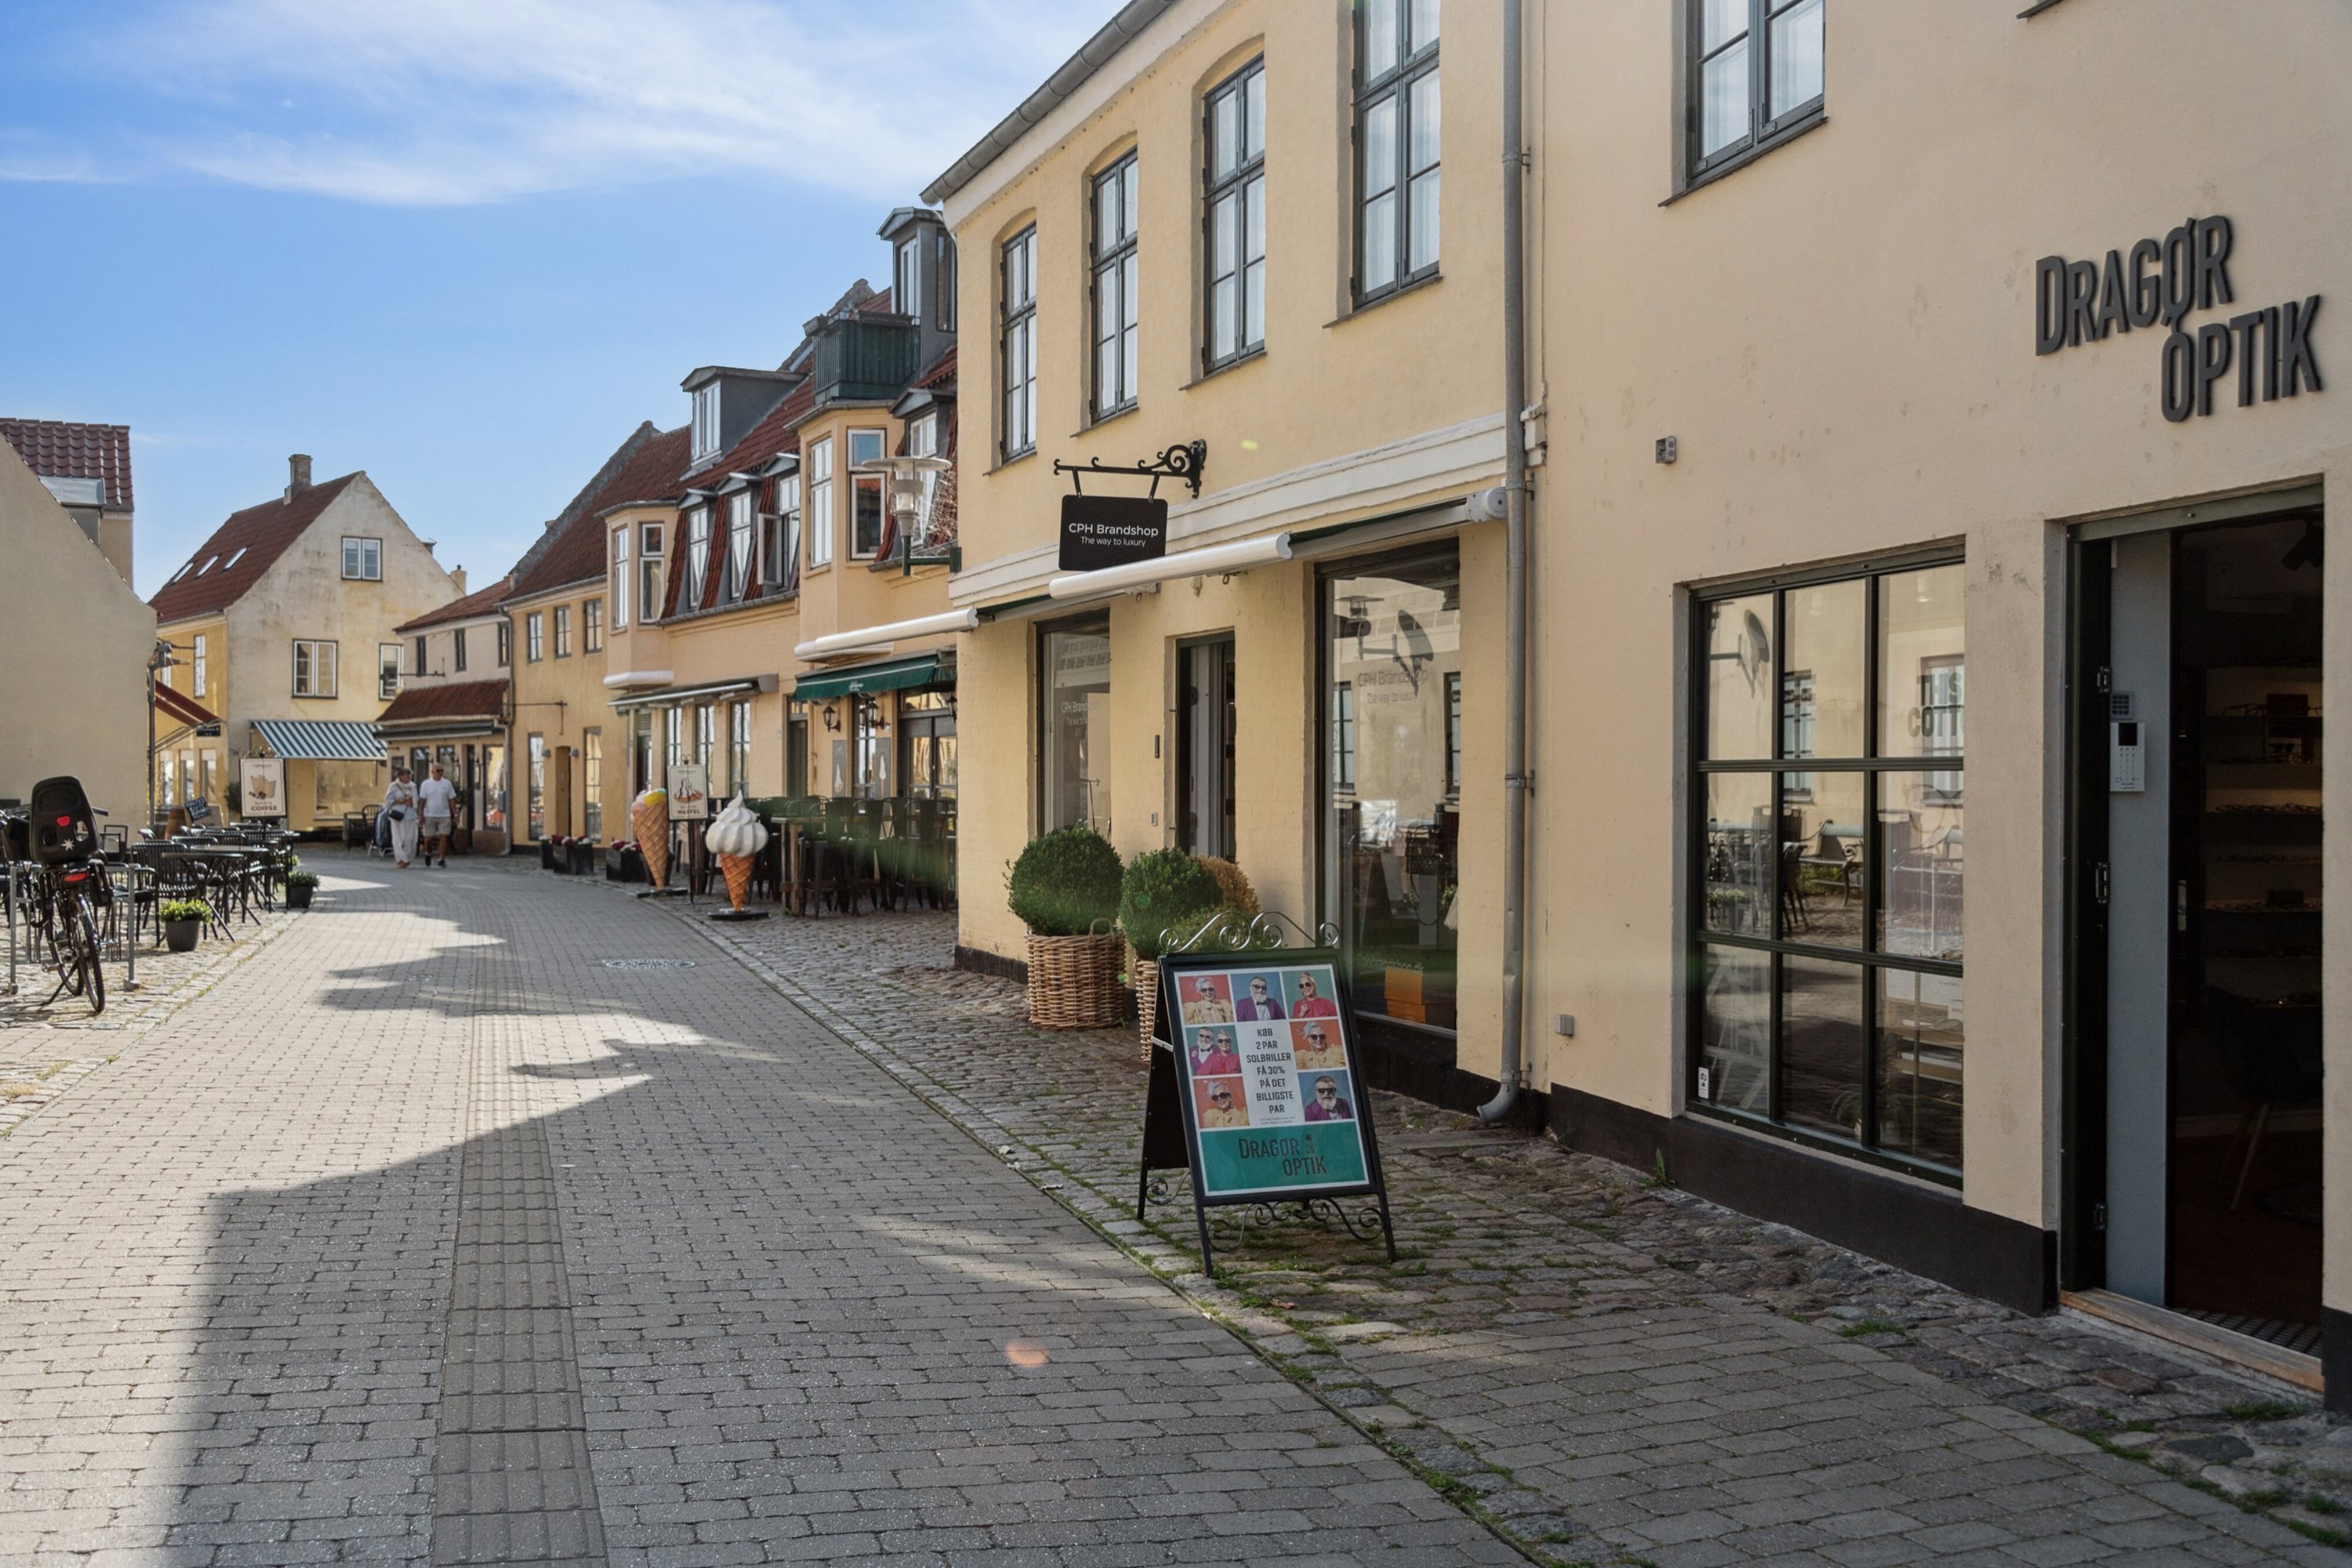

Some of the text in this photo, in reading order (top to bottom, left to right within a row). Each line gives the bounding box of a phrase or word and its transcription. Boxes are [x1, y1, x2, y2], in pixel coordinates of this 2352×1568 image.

[2036, 215, 2234, 356] DRAGØR
[2161, 294, 2323, 423] OPTIK
[1069, 523, 1159, 537] CPH Brandshop
[1081, 536, 1146, 547] The way to luxury
[1907, 706, 1964, 739] COTT
[1257, 1028, 1273, 1036] KØB
[1256, 1040, 1278, 1050] 2 PAR
[1247, 1052, 1291, 1063] SOLBRILLER
[1257, 1065, 1285, 1075] FÅ 30%
[1260, 1078, 1286, 1088] PÅ DET
[1256, 1091, 1294, 1102] BILLIGSTE
[1269, 1104, 1285, 1113] PAR
[1283, 1156, 1327, 1176] OPTIK
